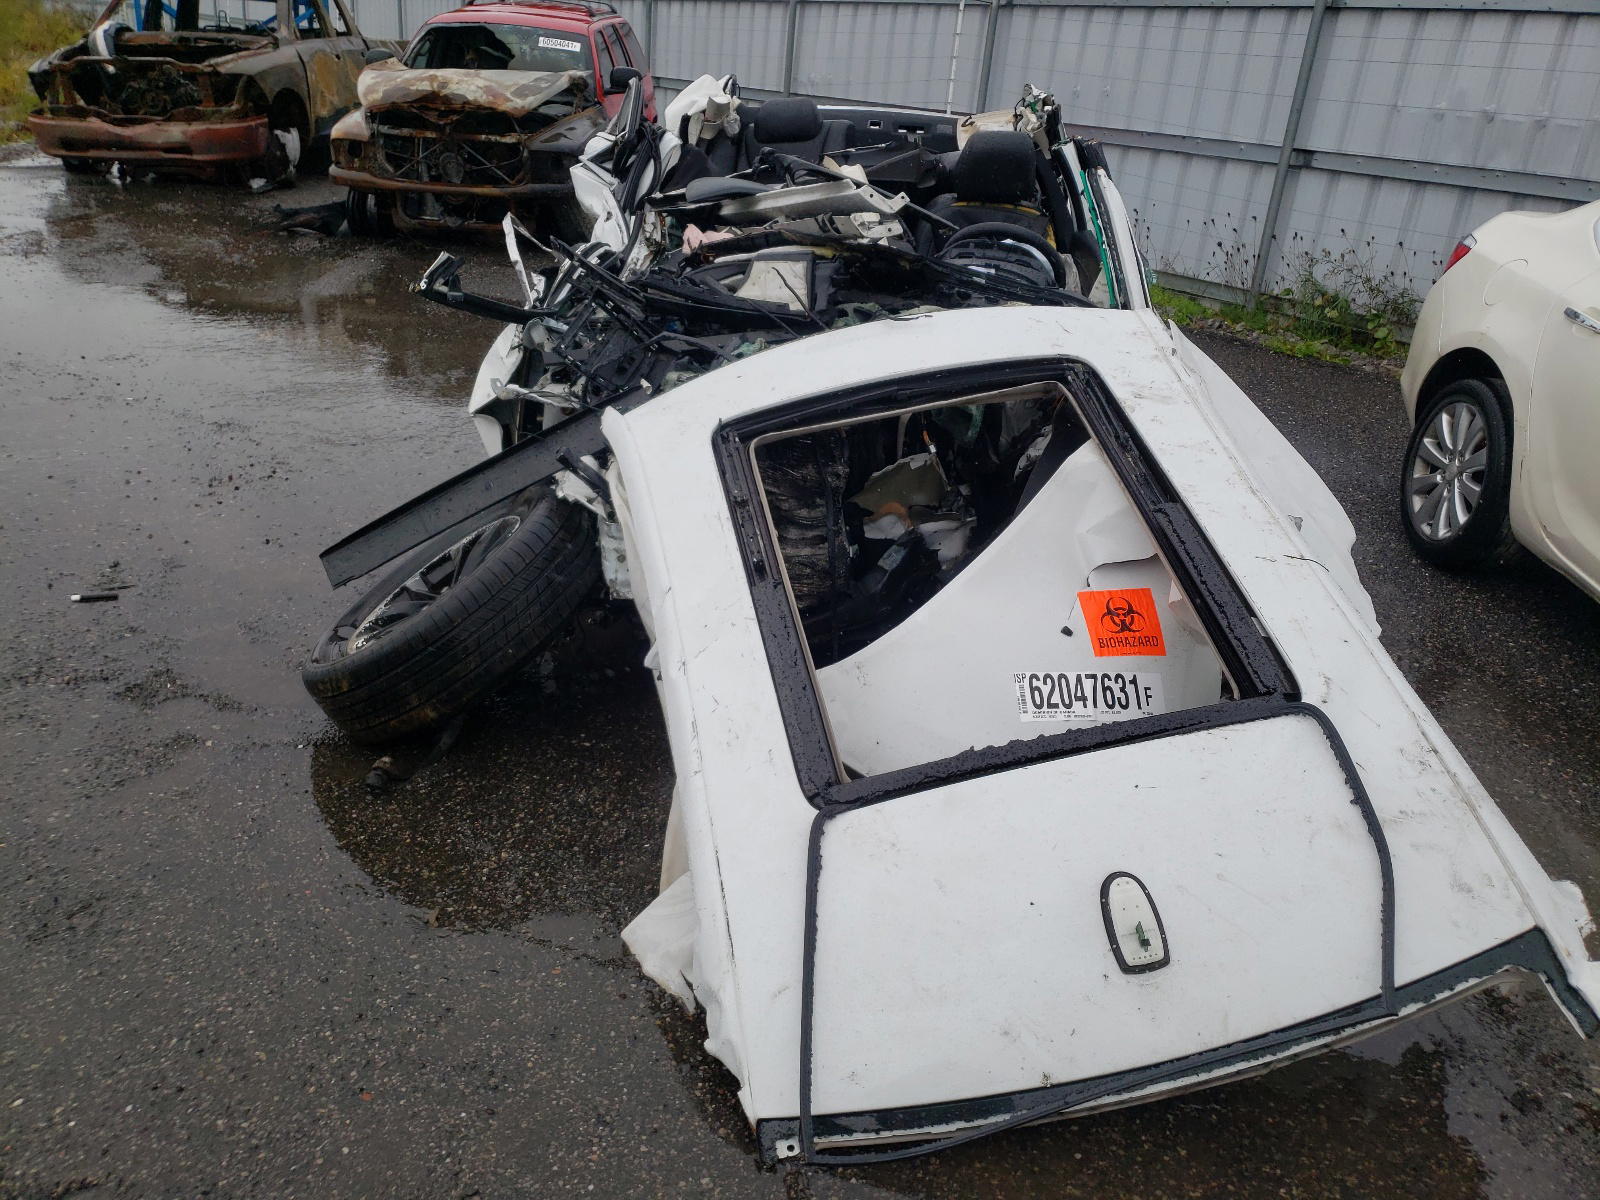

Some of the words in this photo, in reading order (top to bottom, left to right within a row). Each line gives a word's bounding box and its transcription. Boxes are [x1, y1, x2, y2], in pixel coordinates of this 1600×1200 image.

[1098, 636, 1159, 649] BIOHAZARD
[1028, 673, 1143, 710] 62047631
[1143, 687, 1152, 706] F
